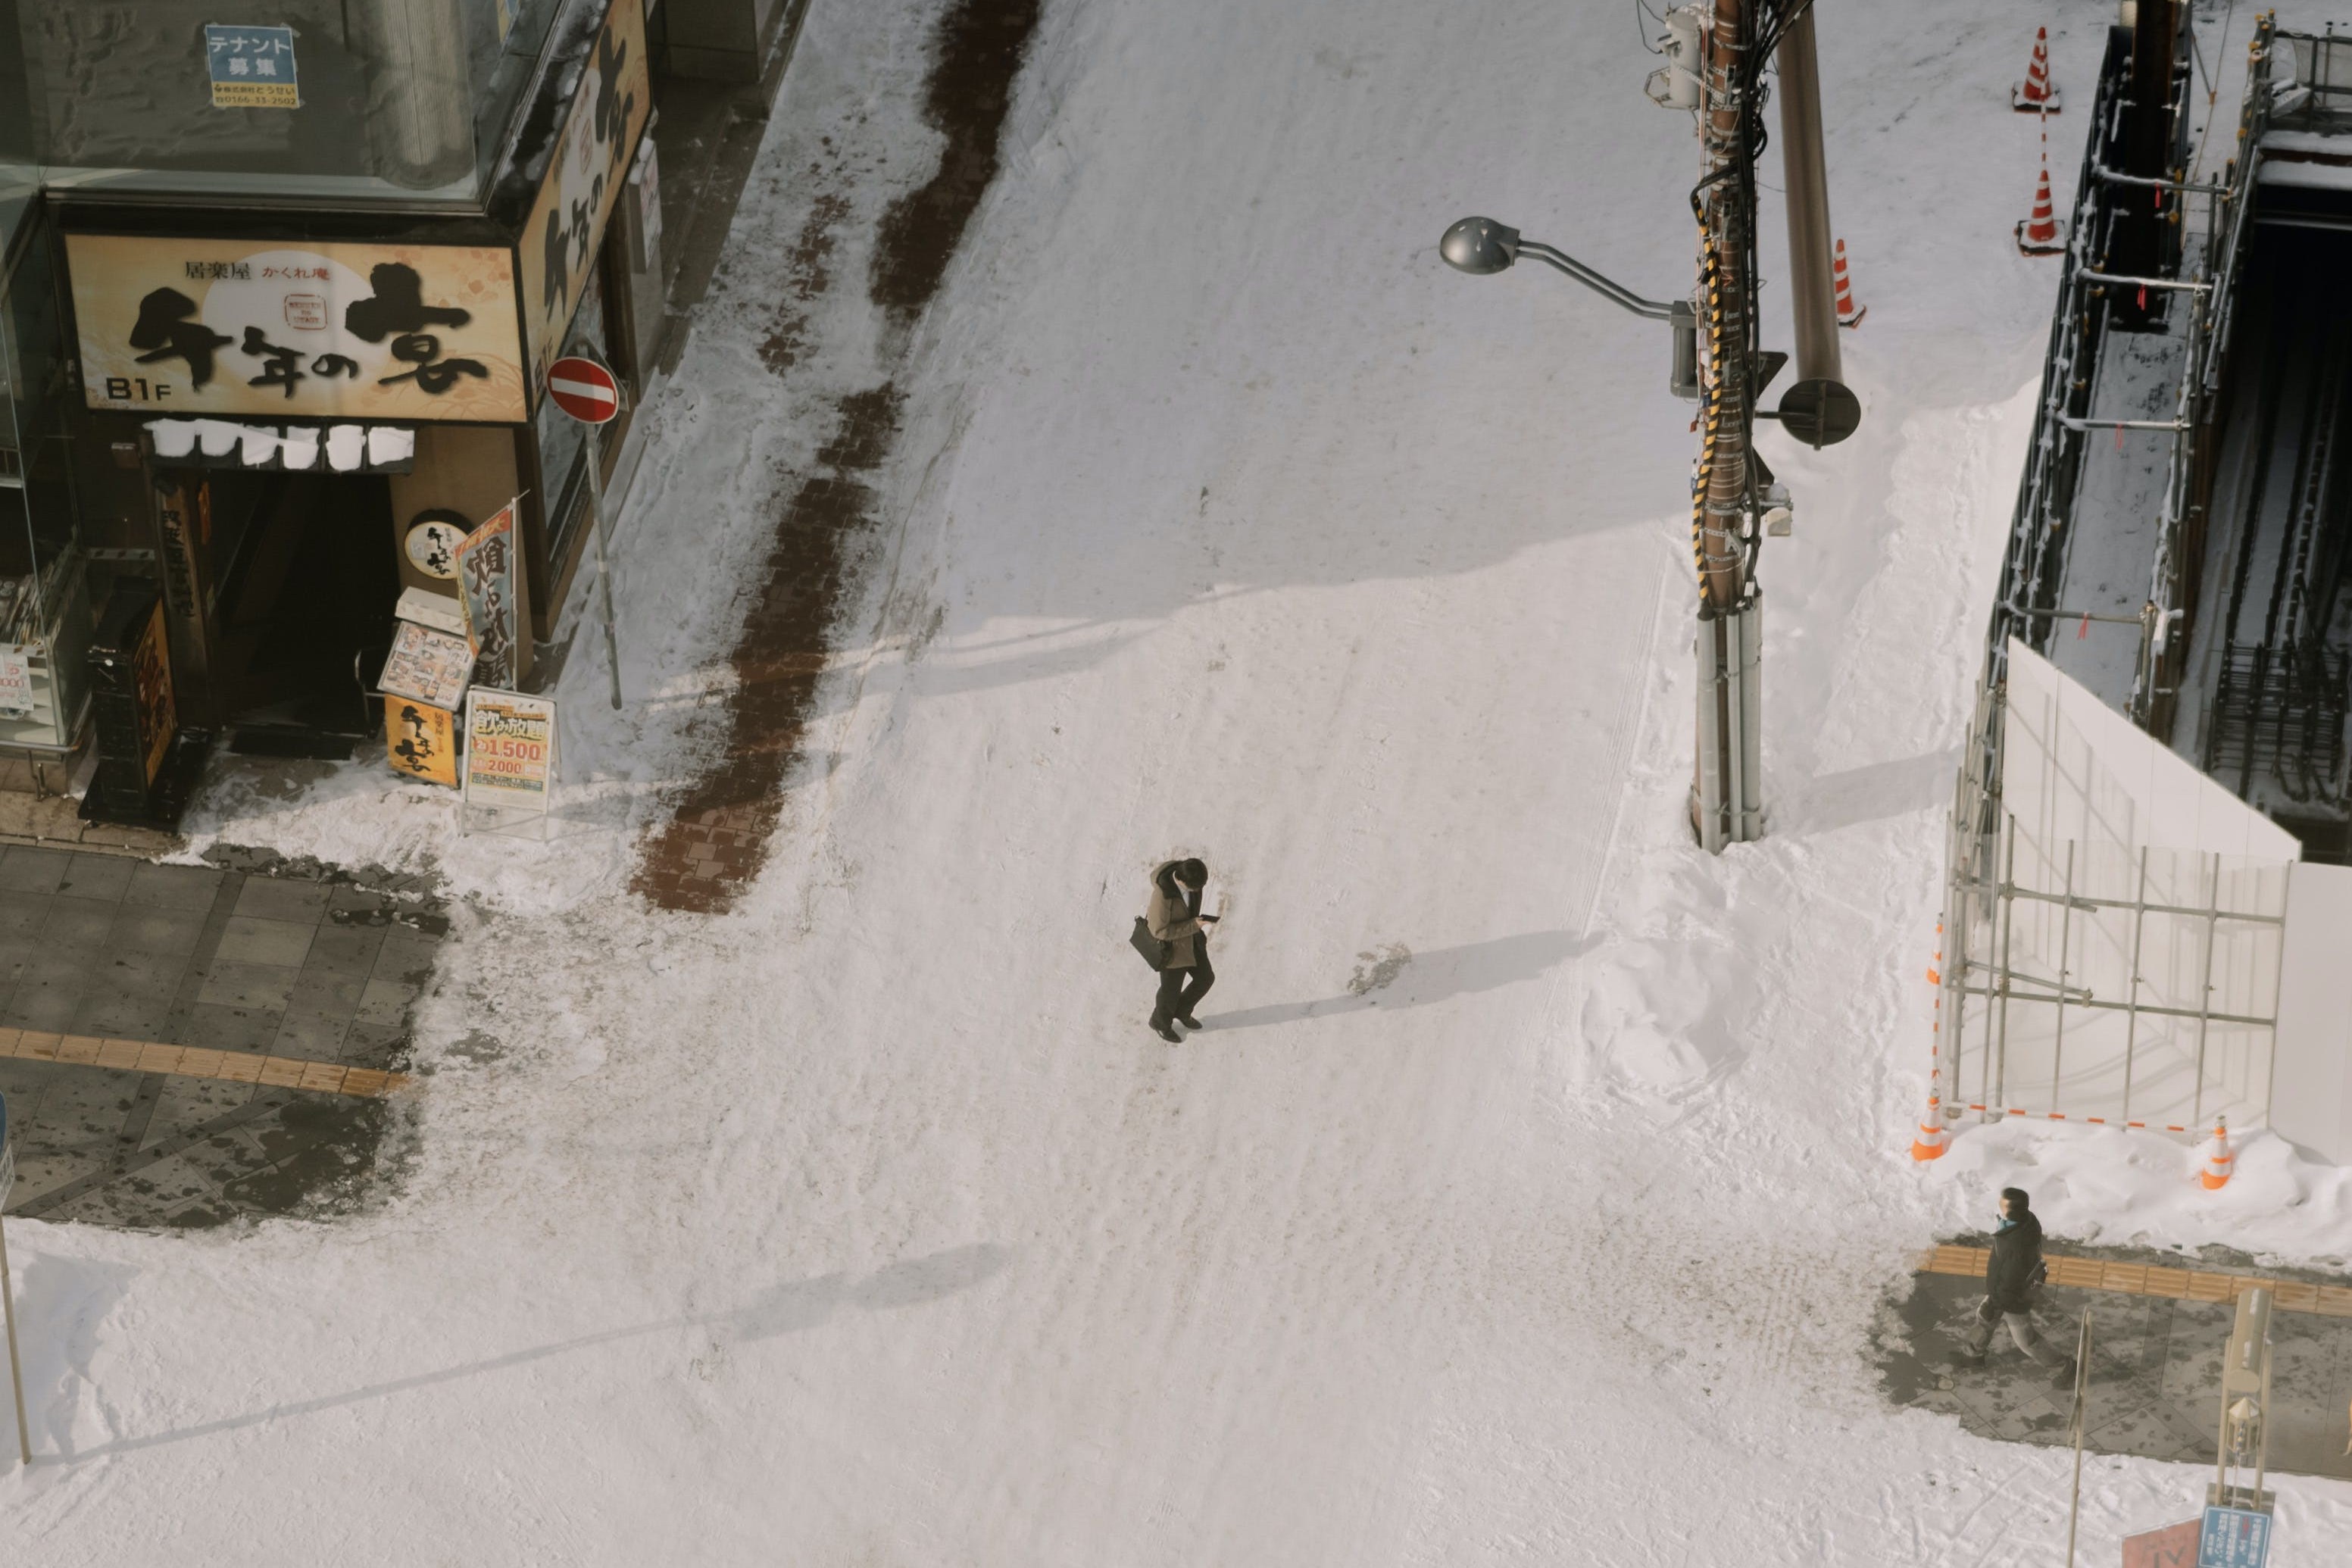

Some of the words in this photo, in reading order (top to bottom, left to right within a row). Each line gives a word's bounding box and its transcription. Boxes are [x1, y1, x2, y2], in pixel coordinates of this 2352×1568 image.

[210, 36, 290, 55] テナント
[228, 57, 277, 76] 募集
[186, 261, 251, 280] 居楽屋
[129, 262, 489, 394] 千年の宴
[106, 378, 171, 401] B1F
[475, 709, 547, 740] 飲み放題
